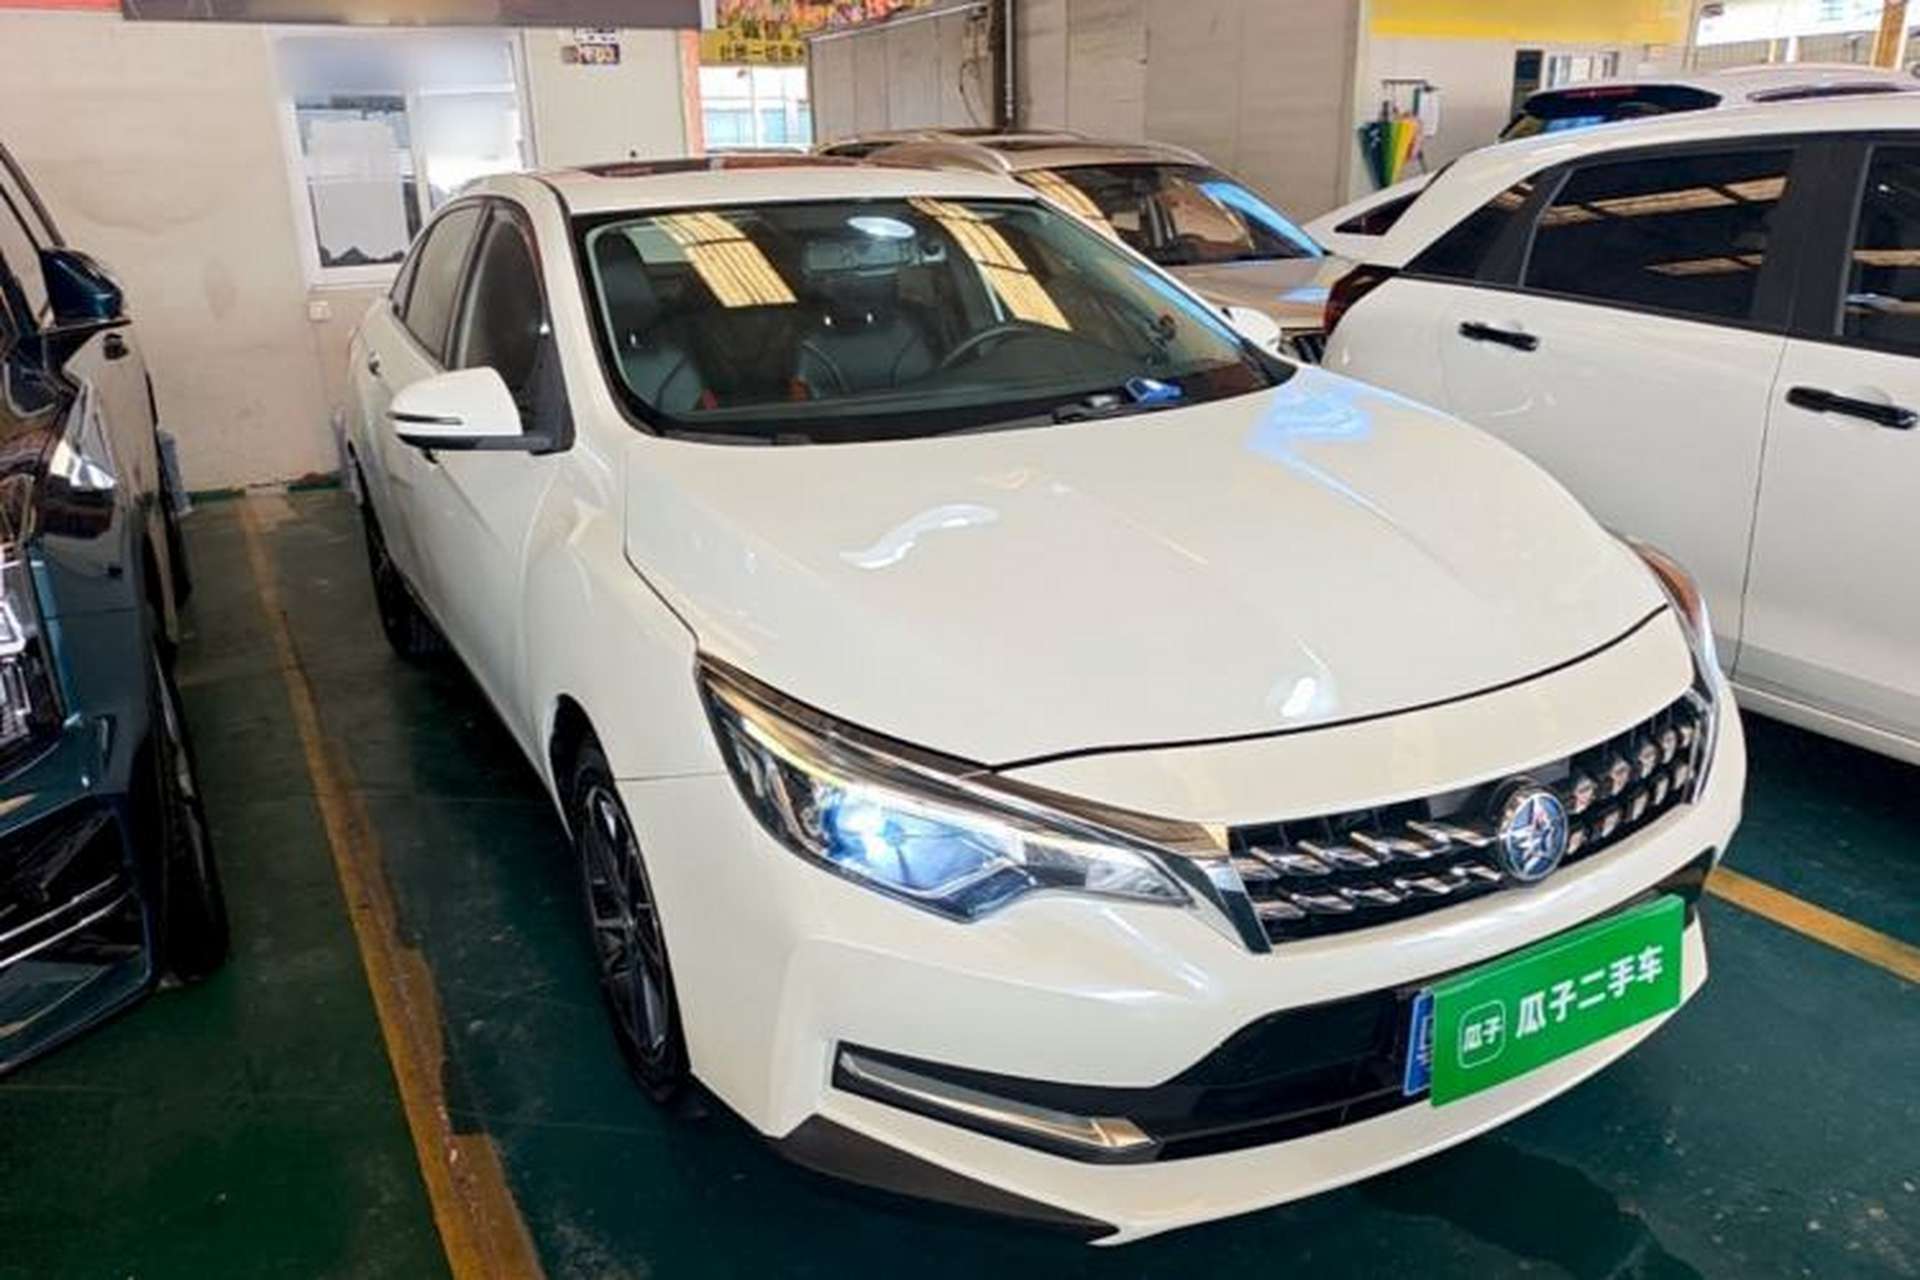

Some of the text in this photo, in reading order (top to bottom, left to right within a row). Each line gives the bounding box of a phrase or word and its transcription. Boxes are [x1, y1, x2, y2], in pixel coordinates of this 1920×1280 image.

[1516, 945, 1664, 1039] 瓜子二手车
[1463, 1016, 1504, 1052] 瓜子
